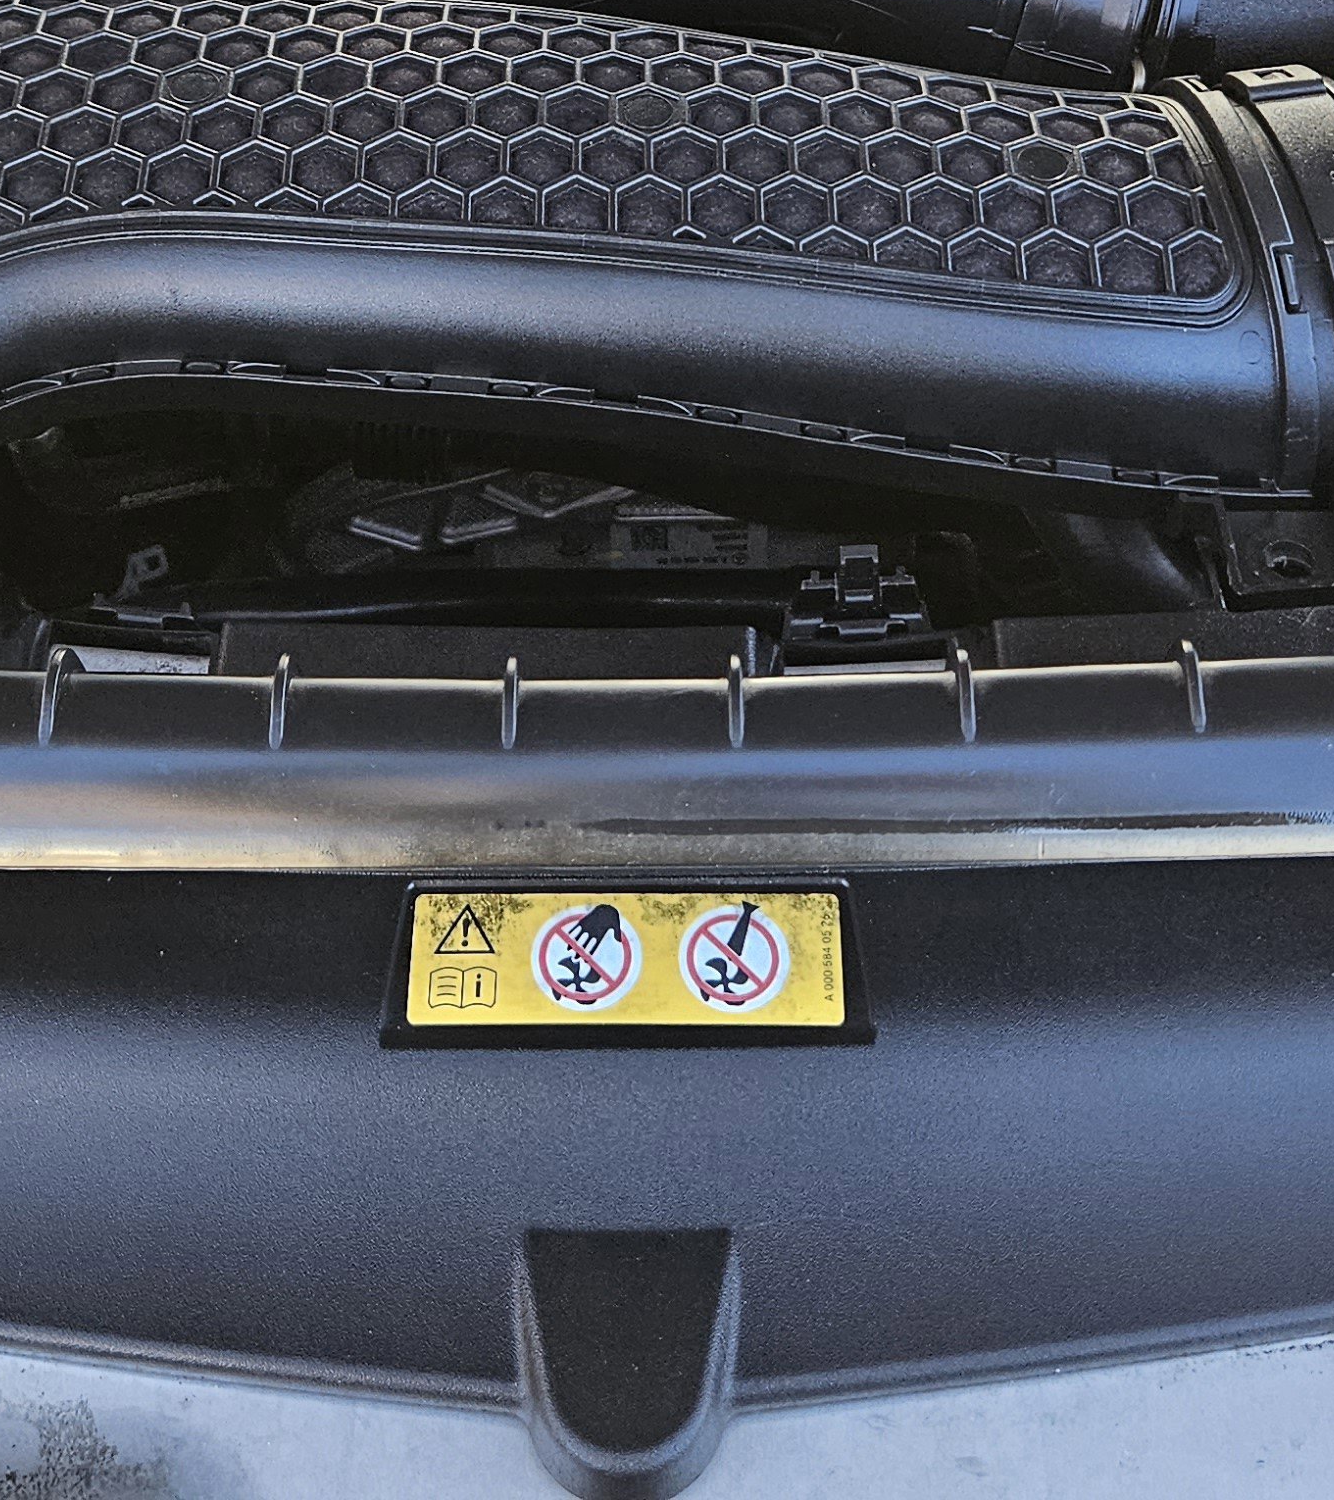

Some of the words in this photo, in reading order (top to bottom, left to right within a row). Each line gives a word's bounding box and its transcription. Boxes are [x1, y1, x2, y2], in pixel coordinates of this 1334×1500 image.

[821, 930, 832, 943] 05
[823, 947, 833, 966] 584
[823, 970, 834, 990] 000
